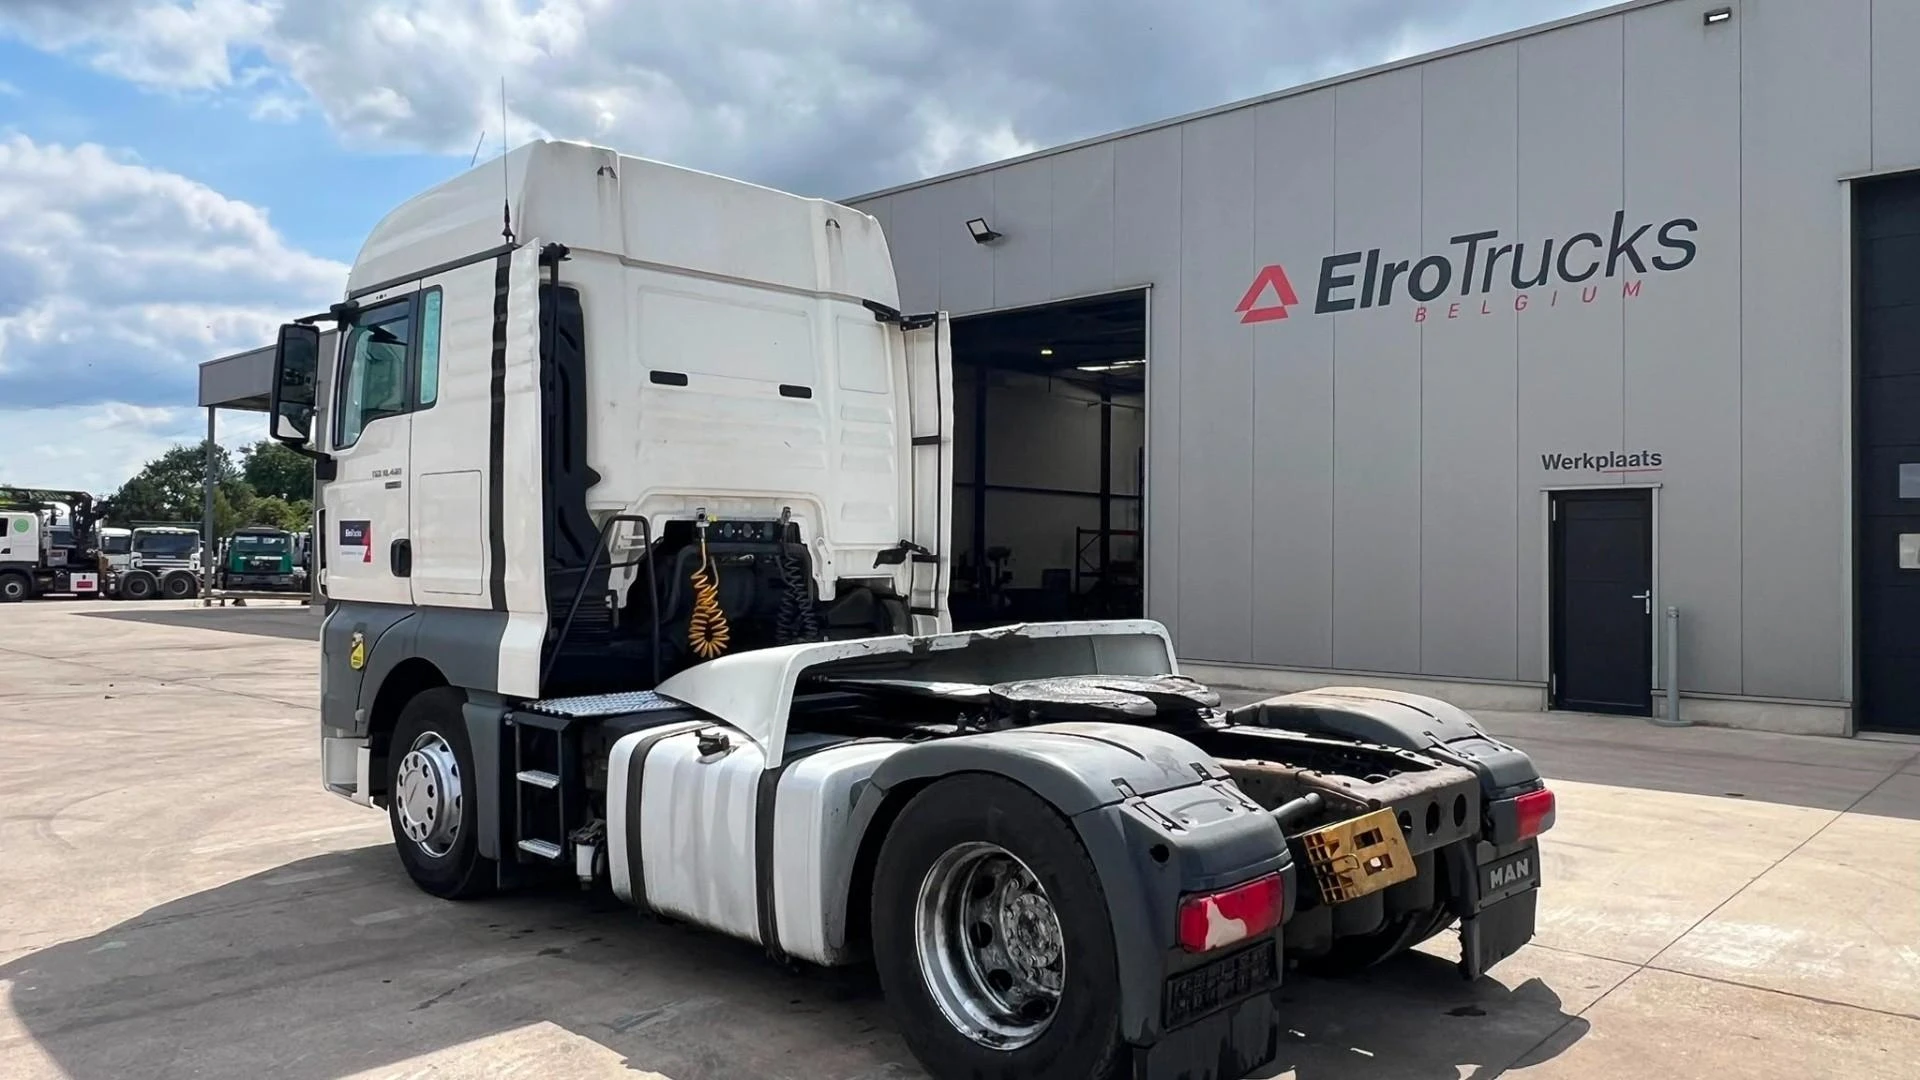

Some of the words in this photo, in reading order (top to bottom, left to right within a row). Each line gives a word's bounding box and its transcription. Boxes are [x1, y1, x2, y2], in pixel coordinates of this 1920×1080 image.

[1315, 210, 1698, 314] ElroTrucks
[1415, 280, 1642, 322] BELGIUM
[1541, 450, 1662, 472] Werkplaats
[1490, 857, 1528, 889] MAN
